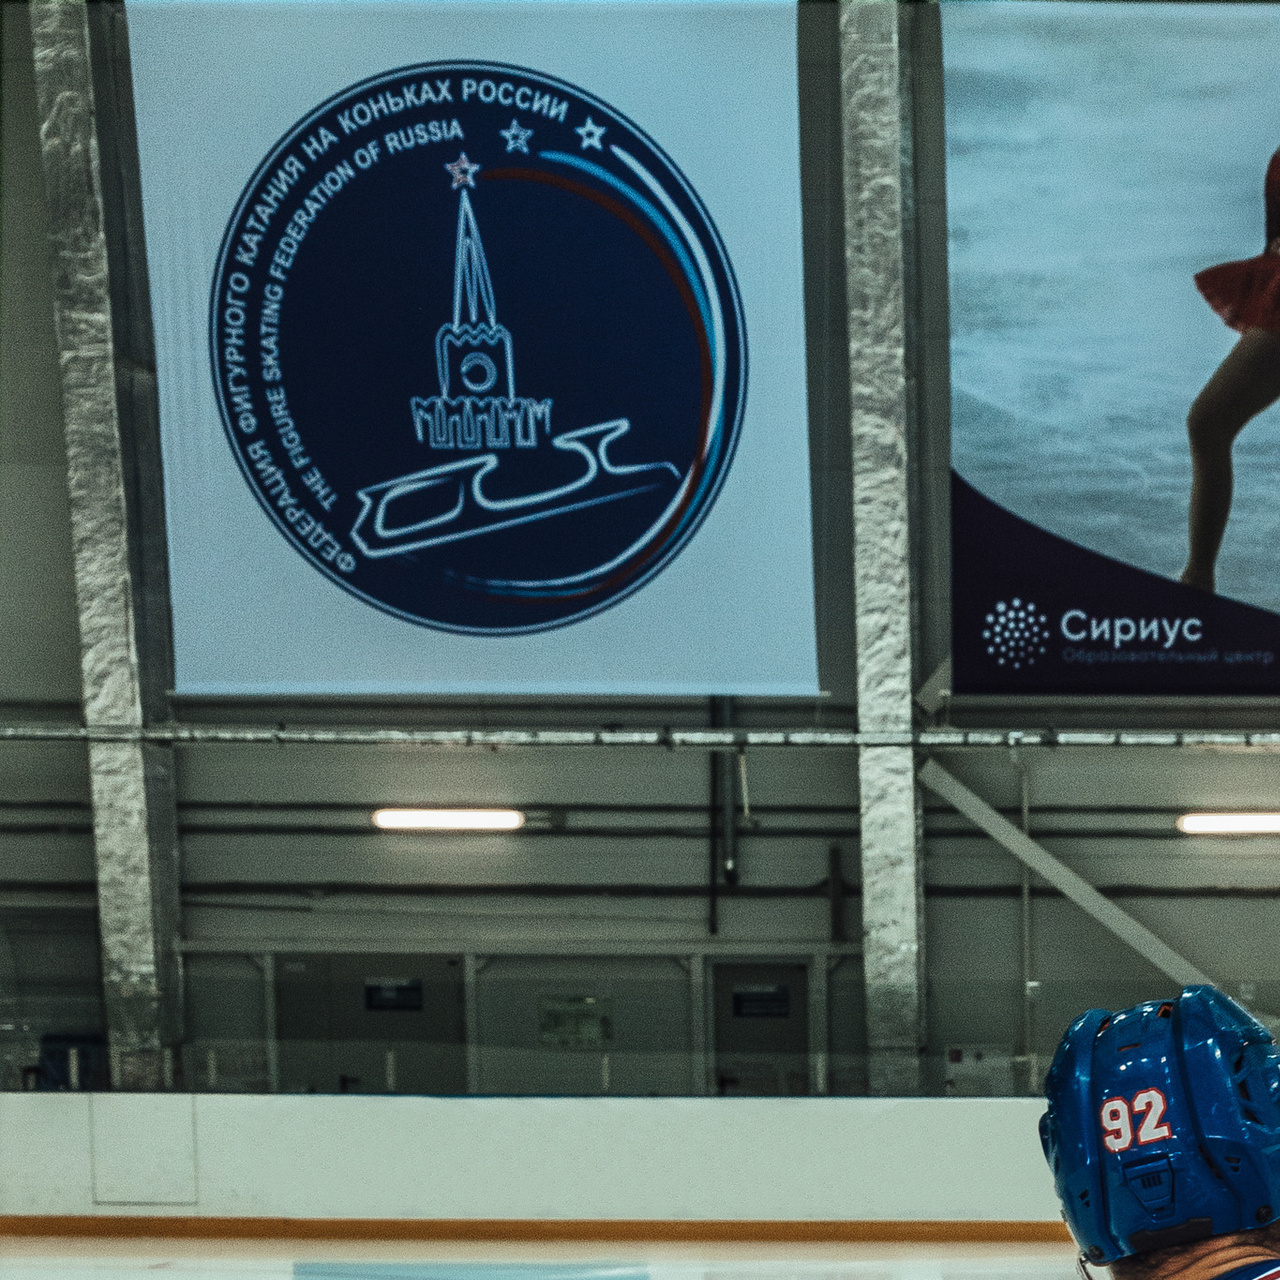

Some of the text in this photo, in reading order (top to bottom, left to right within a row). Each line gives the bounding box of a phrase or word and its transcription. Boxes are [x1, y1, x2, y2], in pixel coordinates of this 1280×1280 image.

[223, 78, 570, 574] ФЕДЕРАЦИЯ ФИГУРНОГО КАТАНИЯ НА КОНЬКАХ РОССИИ
[259, 118, 465, 513] THE FIGURE SKATING FEDERATION OF RUSSIA
[1060, 608, 1203, 649] Сириус
[1100, 1087, 1172, 1153] 92
